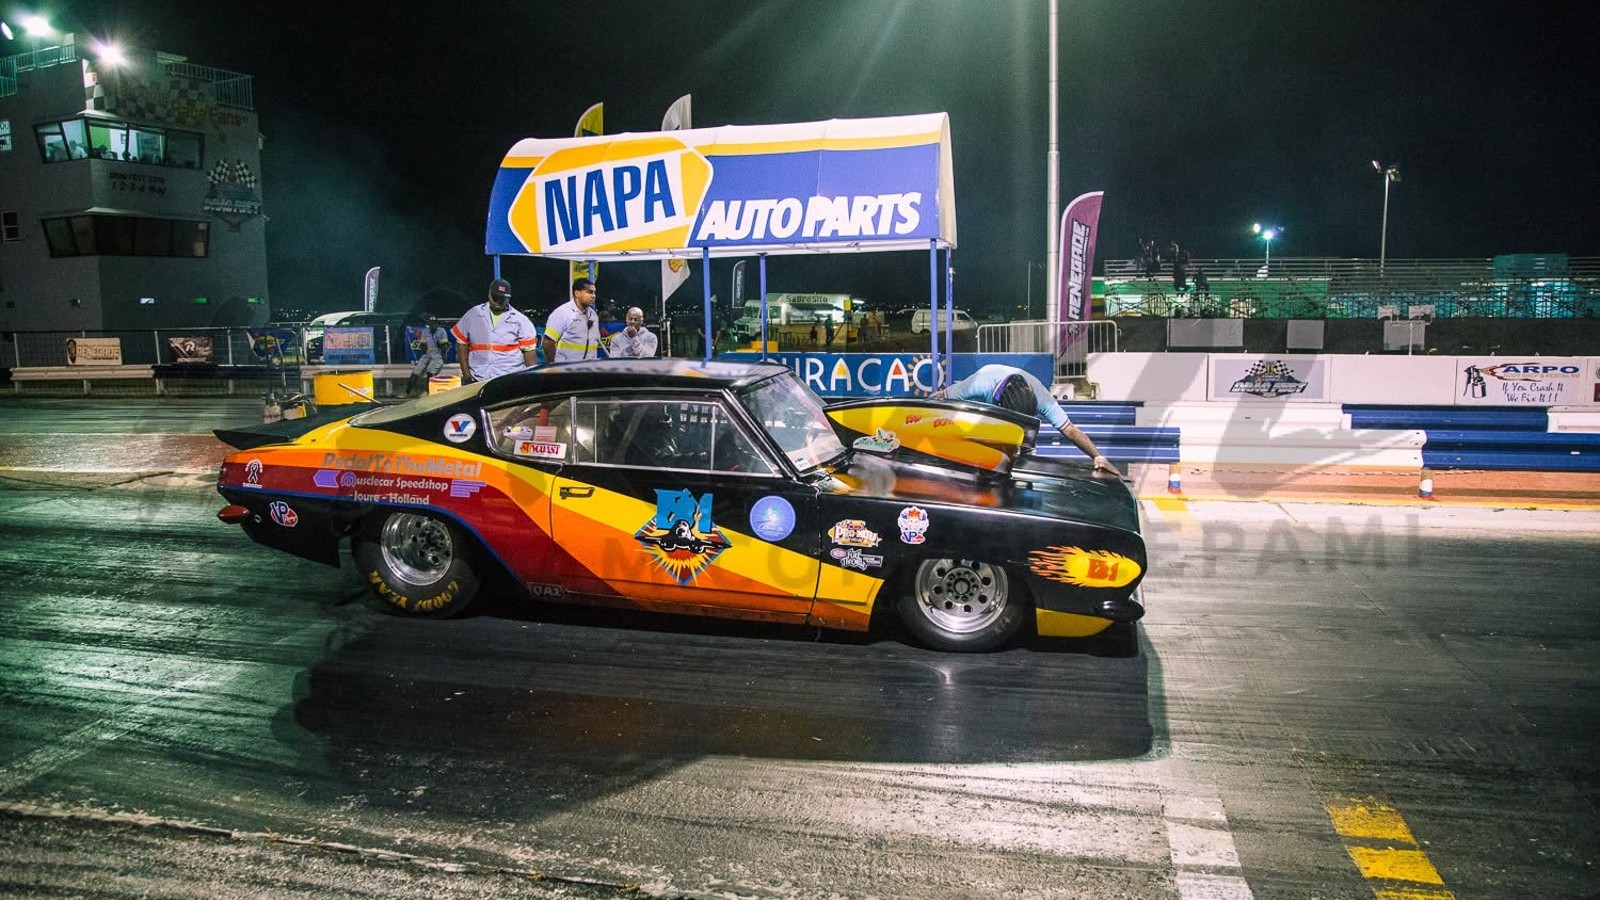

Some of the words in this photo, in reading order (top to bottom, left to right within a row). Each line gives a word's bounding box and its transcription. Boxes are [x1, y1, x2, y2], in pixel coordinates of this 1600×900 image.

[545, 159, 677, 249] NAPA
[1068, 219, 1087, 319] RENEGADE
[760, 357, 944, 394] RACAO
[1502, 365, 1579, 374] ARPO
[1512, 383, 1527, 391] You
[1530, 383, 1552, 391] Crash
[1557, 383, 1563, 391] It
[1507, 394, 1518, 402] We
[1521, 393, 1536, 402] Fix
[396, 477, 449, 493] Speedshop
[389, 493, 430, 505] Holland
[1088, 559, 1119, 581] B1
